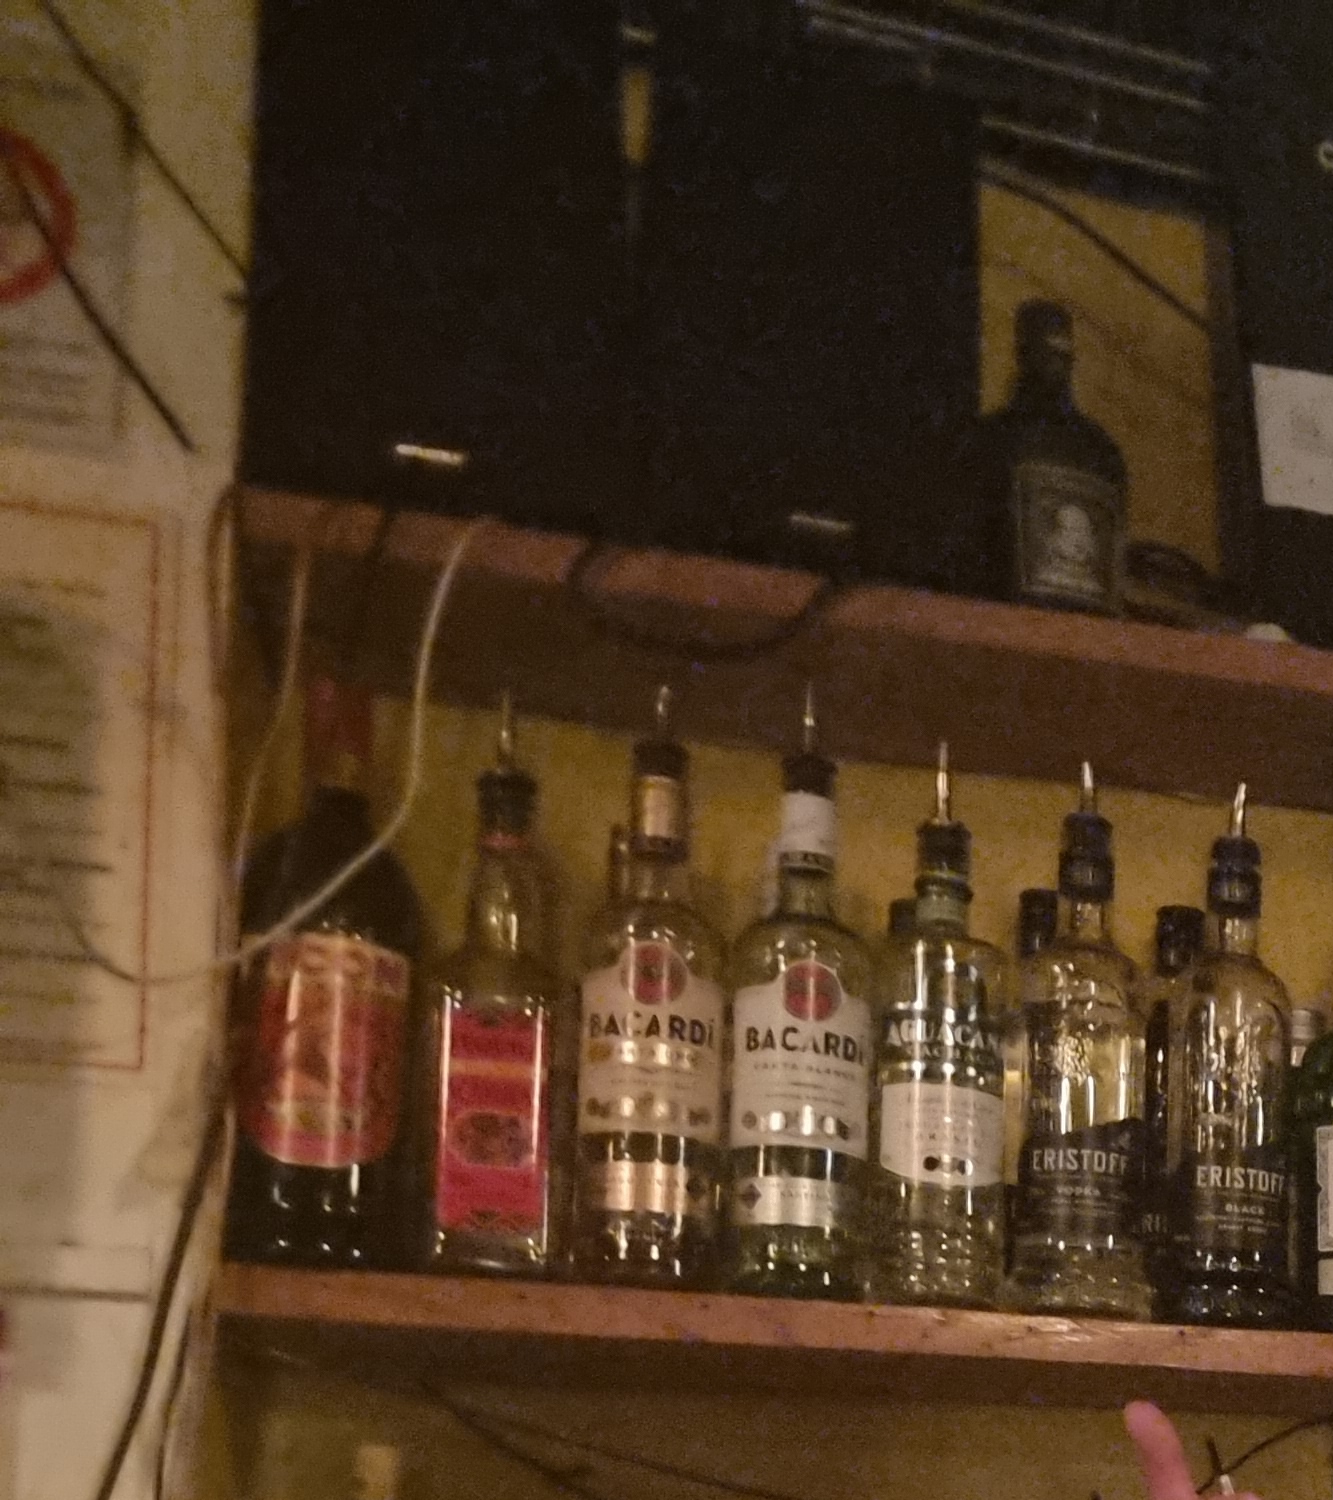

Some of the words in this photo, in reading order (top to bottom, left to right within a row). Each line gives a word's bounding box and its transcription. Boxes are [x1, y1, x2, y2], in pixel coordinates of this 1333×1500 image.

[1033, 1148, 1130, 1176] ERISTOFF
[1196, 1165, 1284, 1196] ERISTOFF
[1225, 1203, 1265, 1216] BLACK
